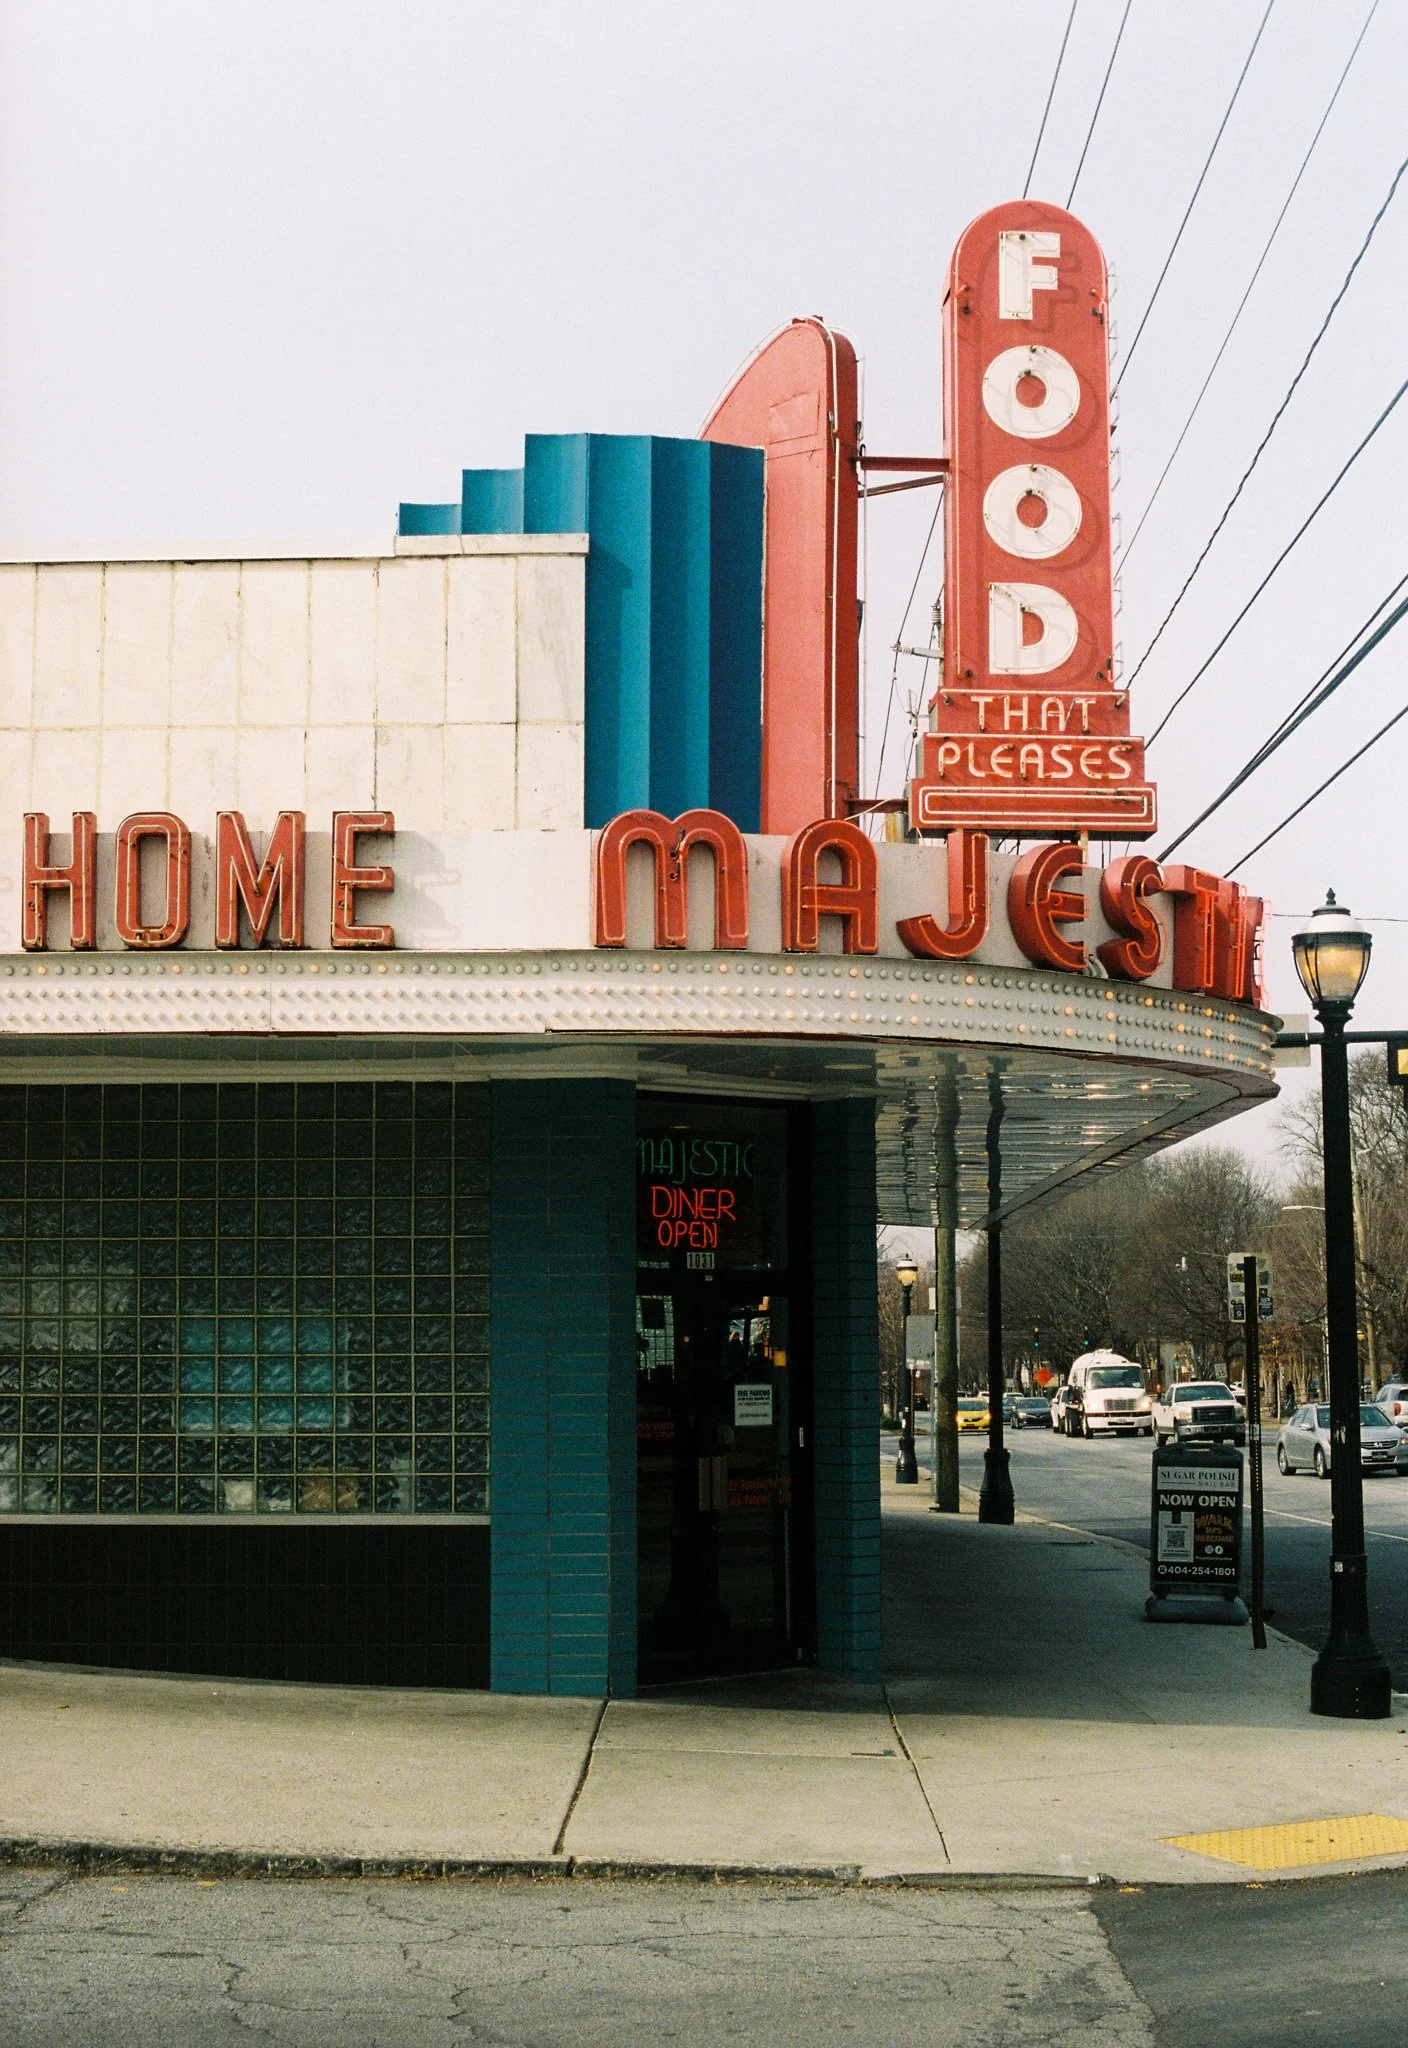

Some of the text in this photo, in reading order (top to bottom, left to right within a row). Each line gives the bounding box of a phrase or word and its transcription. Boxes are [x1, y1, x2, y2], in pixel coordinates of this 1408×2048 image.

[982, 231, 1083, 675] FOOD
[970, 695, 1097, 733] THAT
[936, 743, 1133, 780] PLEASES
[21, 810, 395, 951] HOME
[651, 1186, 736, 1221] DINER
[657, 1220, 719, 1249] OPEN
[689, 1252, 714, 1269] 1031
[1160, 1471, 1236, 1481] SUGAR POLISH
[1159, 1494, 1236, 1507] NOW OPEN
[1167, 1566, 1236, 1577] 404-254-1801
